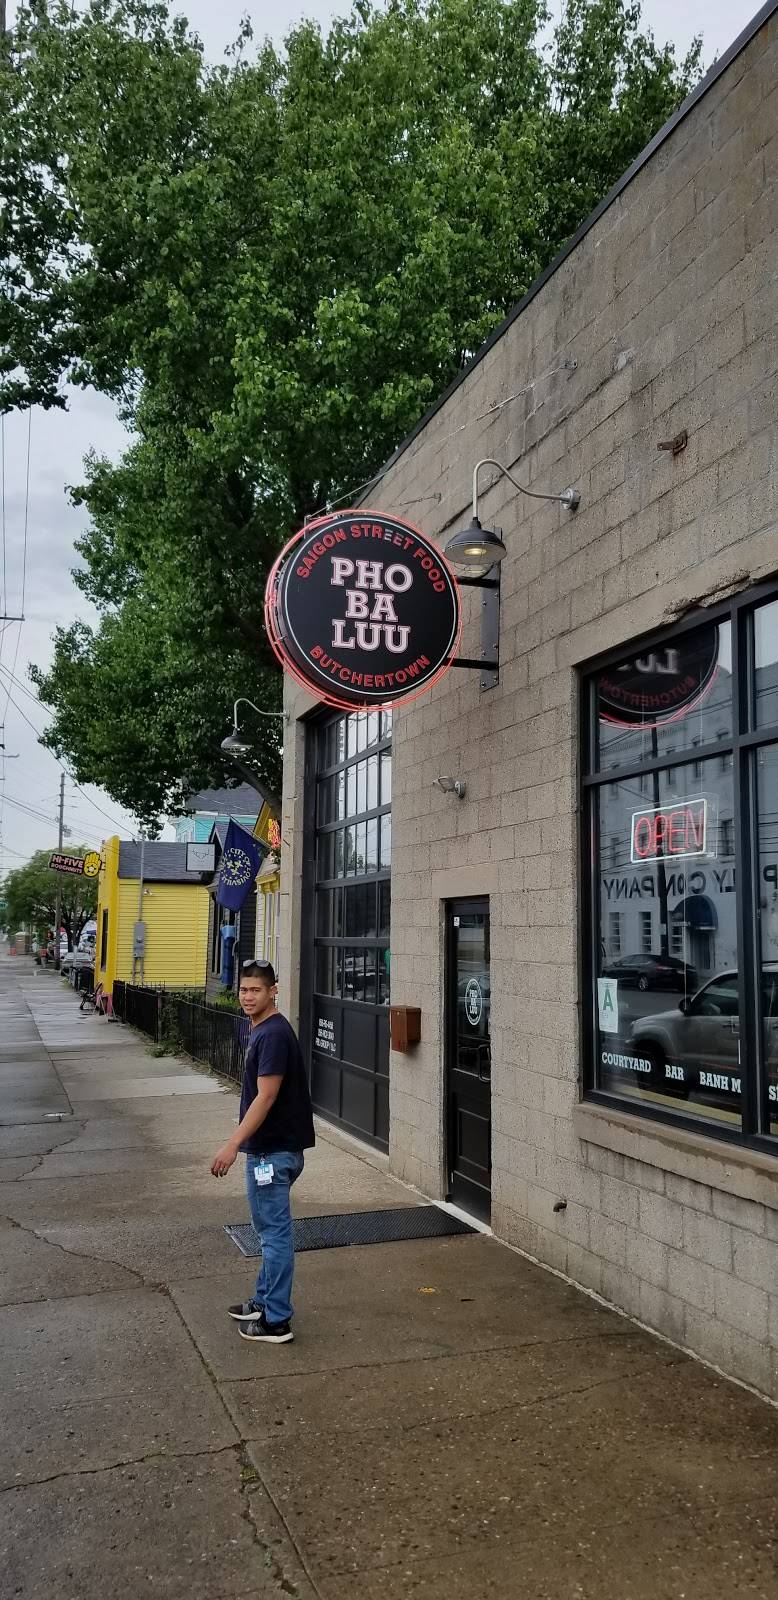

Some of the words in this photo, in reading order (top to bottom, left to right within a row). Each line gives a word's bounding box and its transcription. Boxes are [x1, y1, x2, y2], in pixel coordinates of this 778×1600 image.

[296, 528, 348, 579] SAIGON
[350, 524, 415, 551] STREET
[412, 547, 446, 593] FOOD
[330, 556, 414, 593] PHO
[345, 589, 399, 623] BA
[331, 618, 412, 654] LUU
[309, 645, 431, 688] BUTCHERTOWN
[634, 806, 704, 857] OPEN
[52, 854, 84, 869] HI-FIVE
[602, 988, 614, 1012] A
[601, 1052, 652, 1073] COURTYARD
[664, 1064, 685, 1081] BAR
[699, 1071, 729, 1091] BANH
